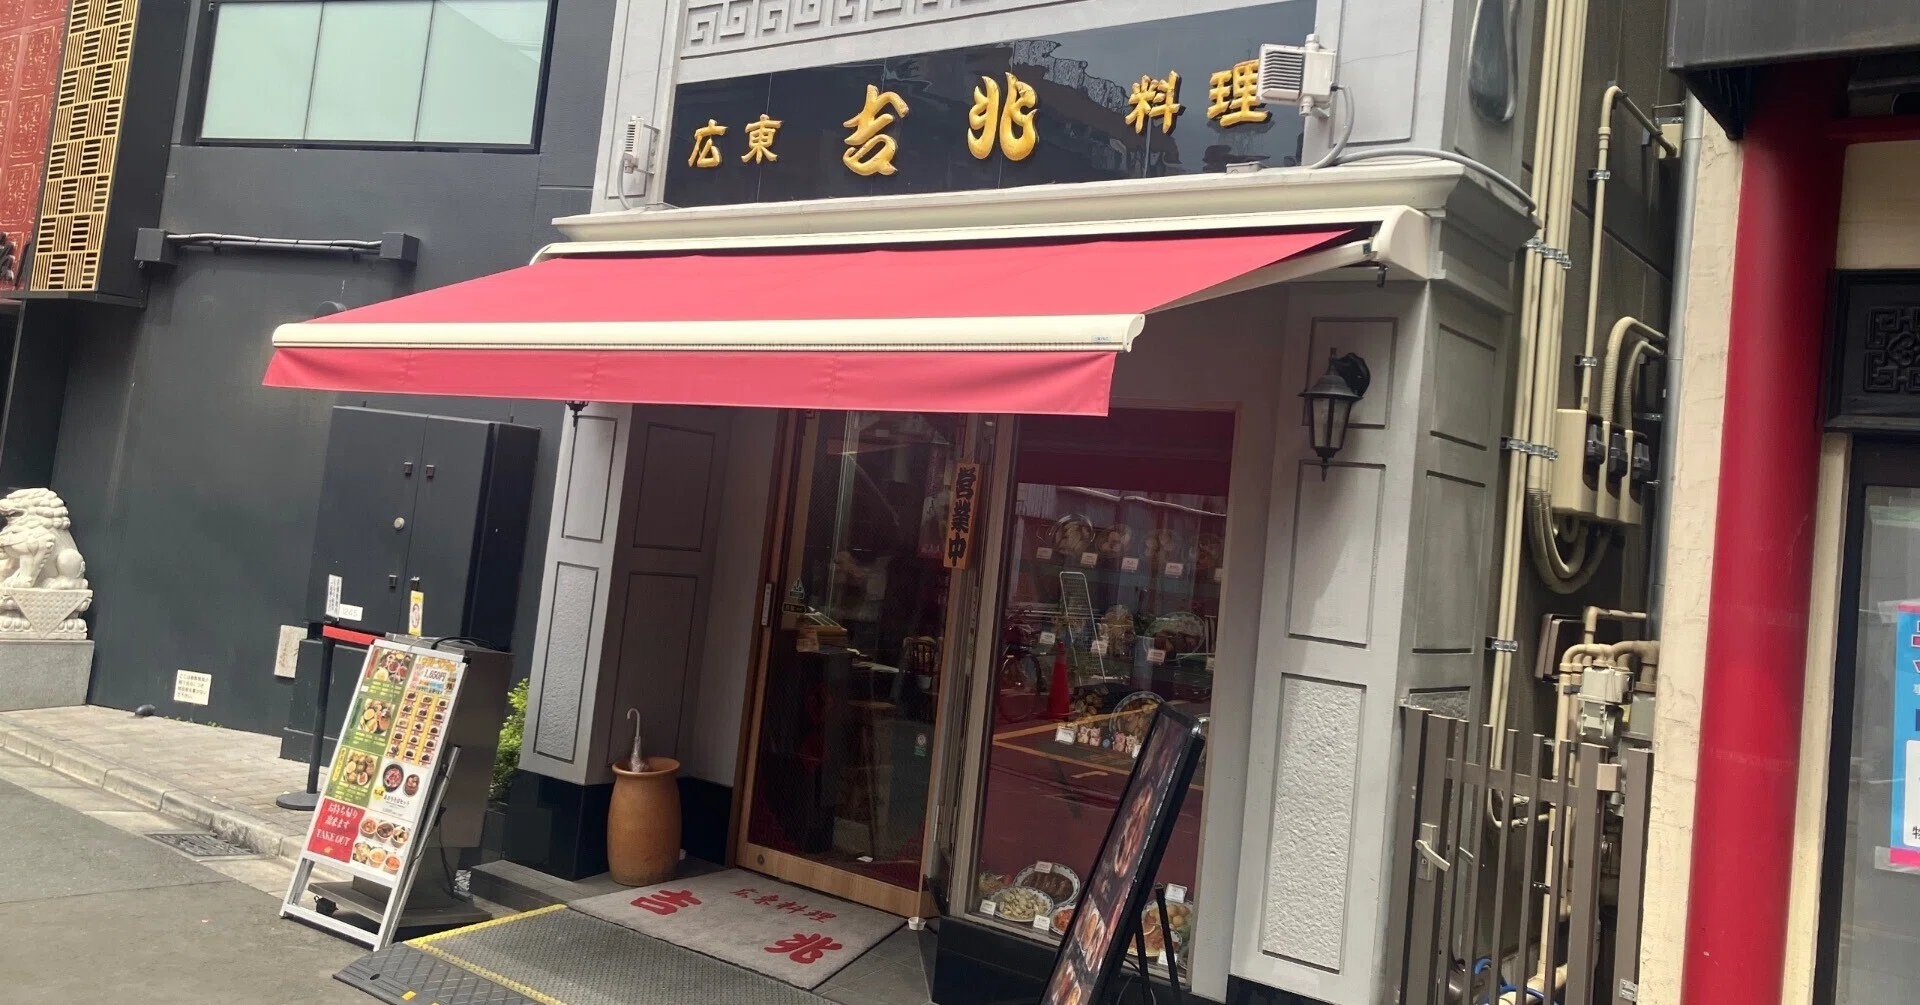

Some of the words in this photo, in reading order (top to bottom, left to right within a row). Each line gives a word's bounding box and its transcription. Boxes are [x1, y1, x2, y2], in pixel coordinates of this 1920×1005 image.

[688, 113, 783, 168] 広東
[843, 73, 1038, 176] 吉兆
[1126, 60, 1268, 132] 料理
[949, 466, 976, 567] 営業中
[316, 828, 336, 843] TAKE
[336, 834, 351, 847] OUT
[729, 887, 838, 923] 広東料理
[763, 933, 843, 964] 兆
